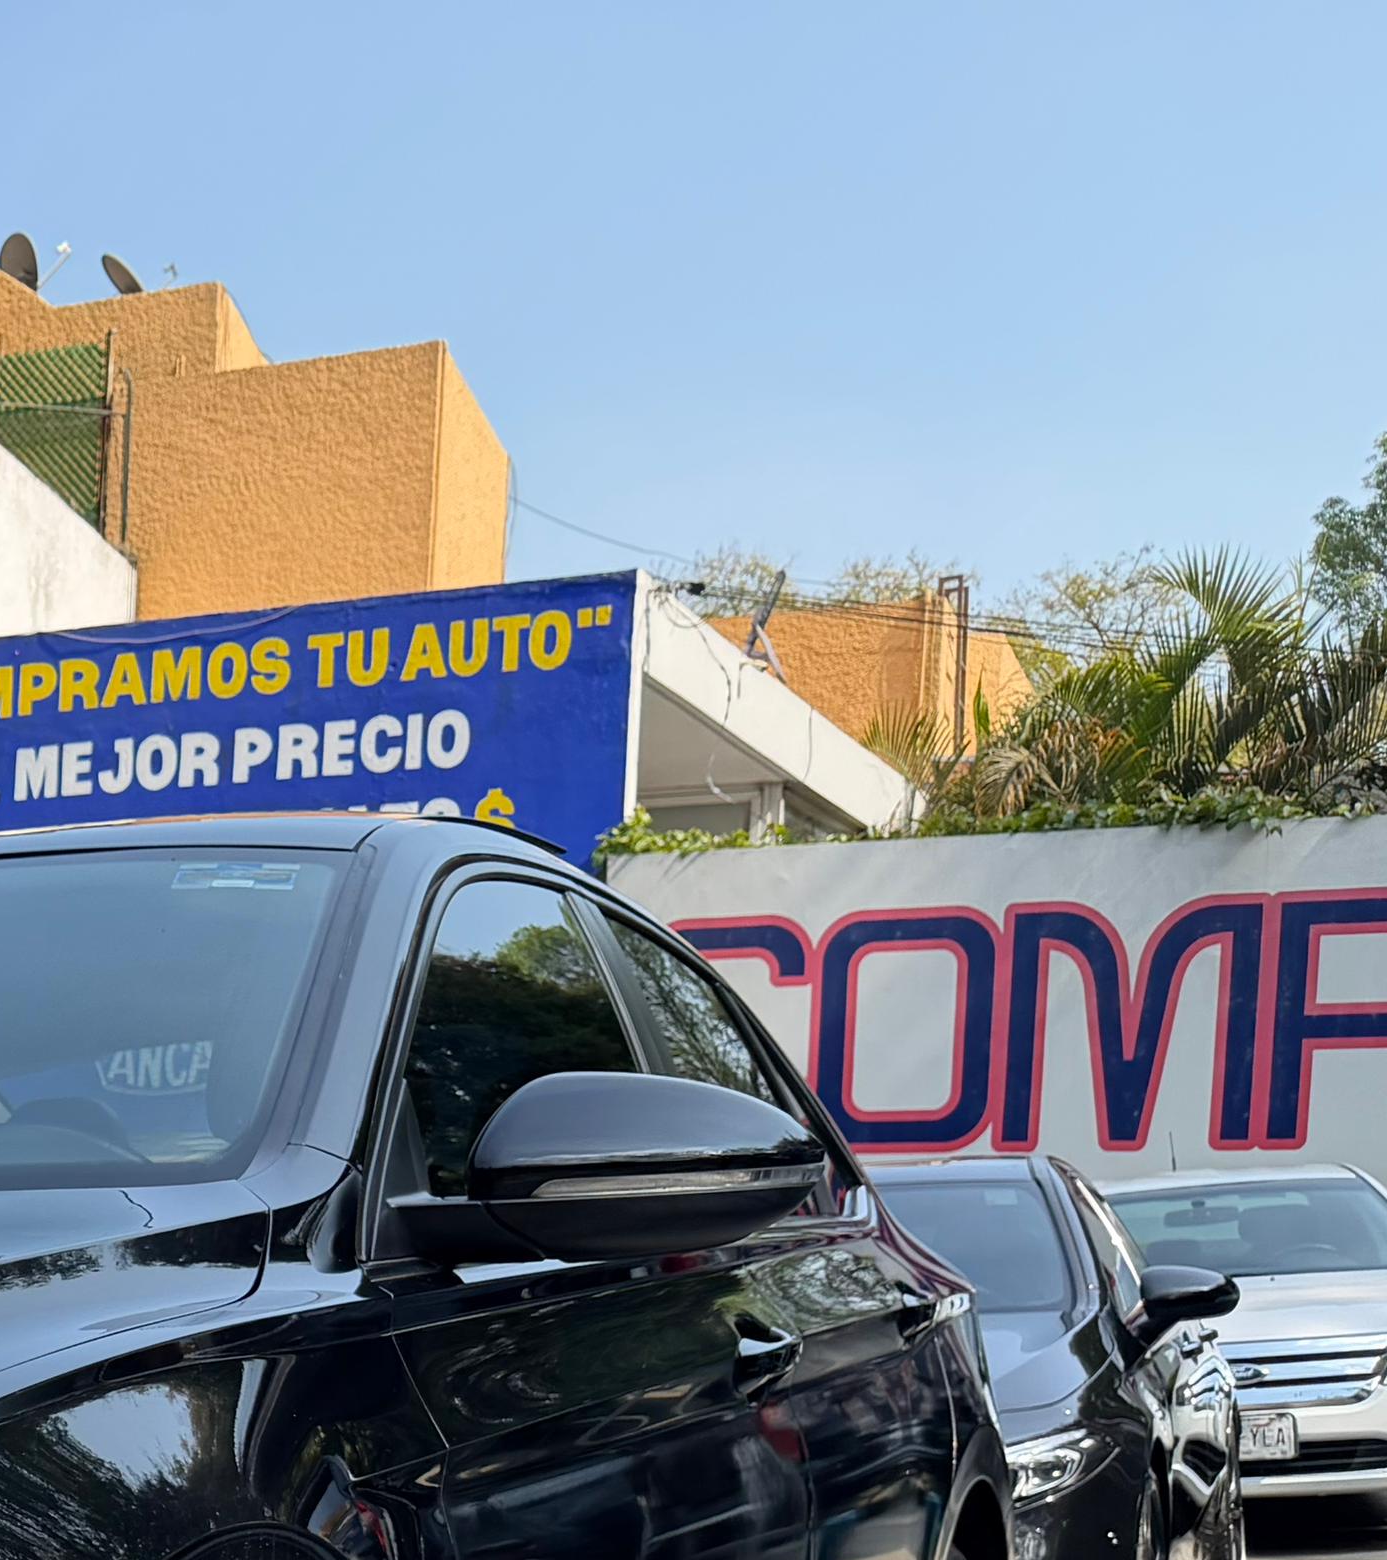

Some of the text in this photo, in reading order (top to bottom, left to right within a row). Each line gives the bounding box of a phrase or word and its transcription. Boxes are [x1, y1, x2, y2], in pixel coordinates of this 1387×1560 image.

[308, 626, 390, 689] TU
[401, 605, 613, 682] AUTO"
[14, 731, 221, 802] MEJOR
[233, 709, 471, 784] PRECIO
